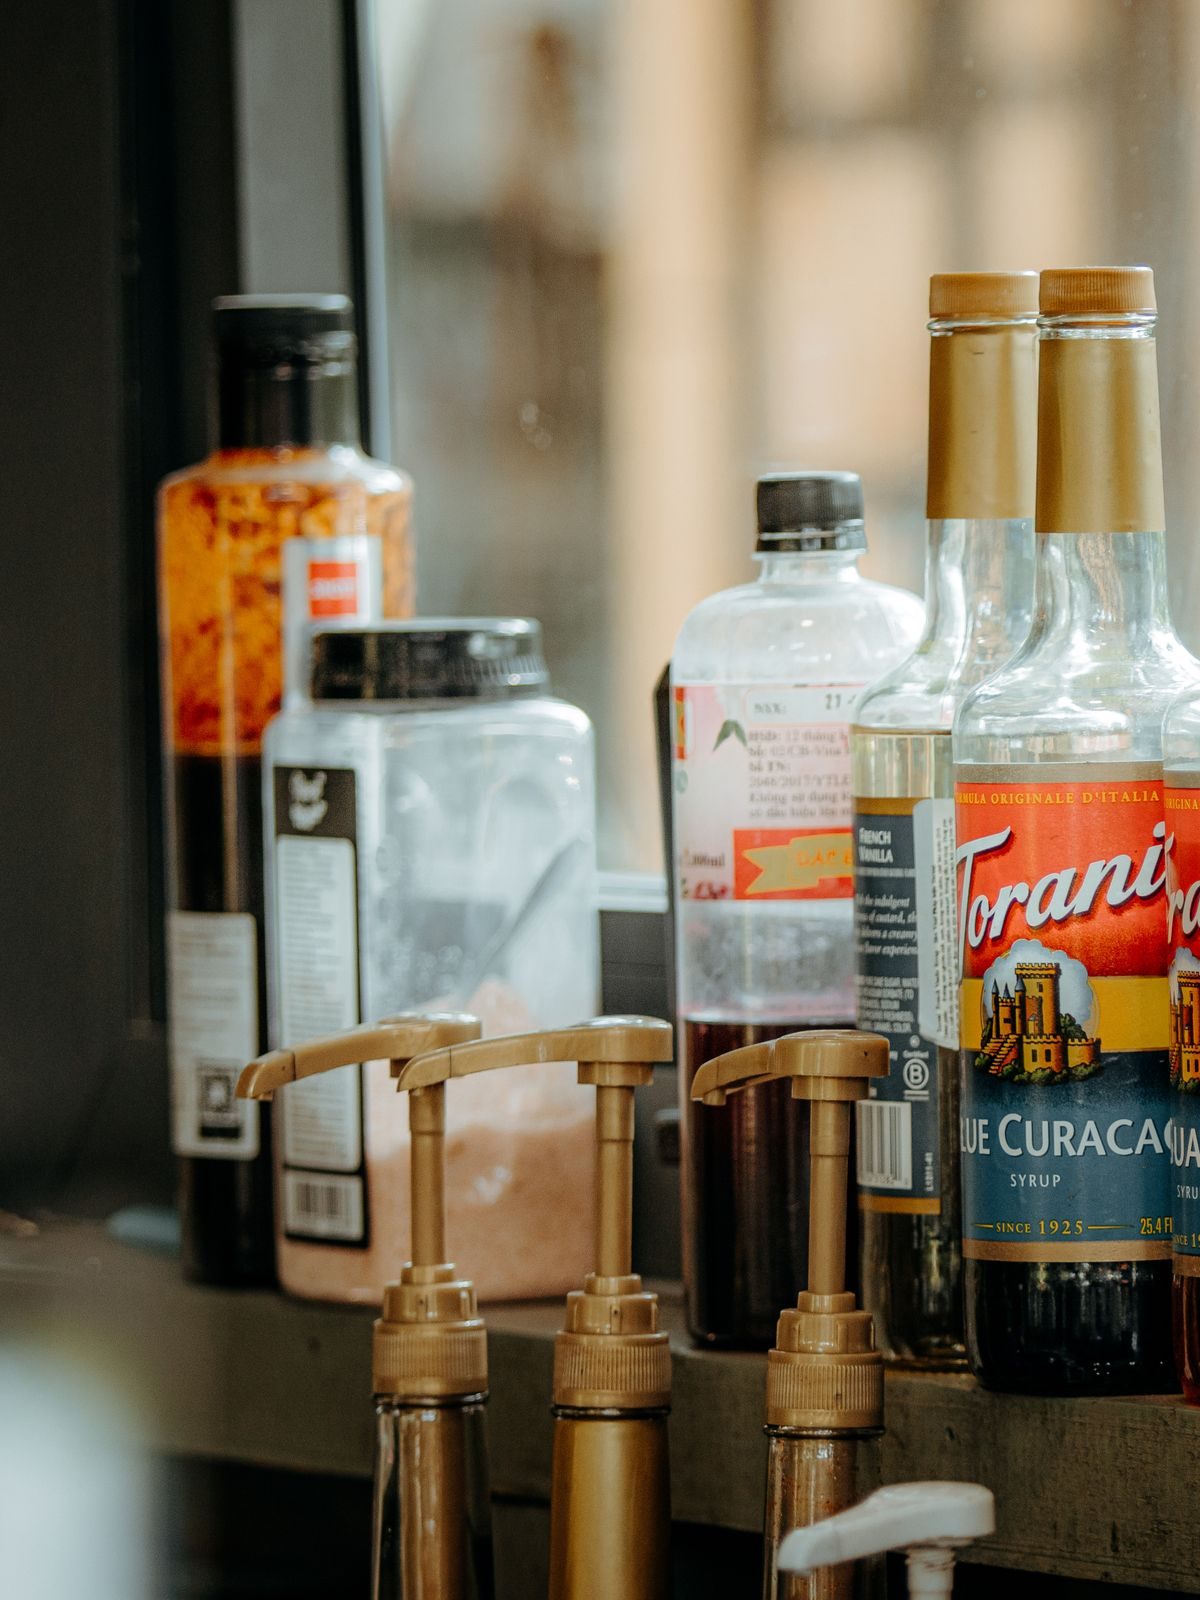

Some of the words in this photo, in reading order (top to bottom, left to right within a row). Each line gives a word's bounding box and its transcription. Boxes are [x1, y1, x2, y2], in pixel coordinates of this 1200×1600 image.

[991, 791, 1075, 806] ORIGINALE
[1082, 790, 1159, 804] D'ITALIA
[859, 846, 894, 863] VANILLA
[956, 821, 1166, 986] Torani
[960, 1117, 990, 1155] LUE
[1010, 1174, 1061, 1188] SYRUP
[996, 1222, 1031, 1234] SINCE
[1038, 1220, 1083, 1235] 1925
[1140, 1216, 1162, 1236] 25.4
